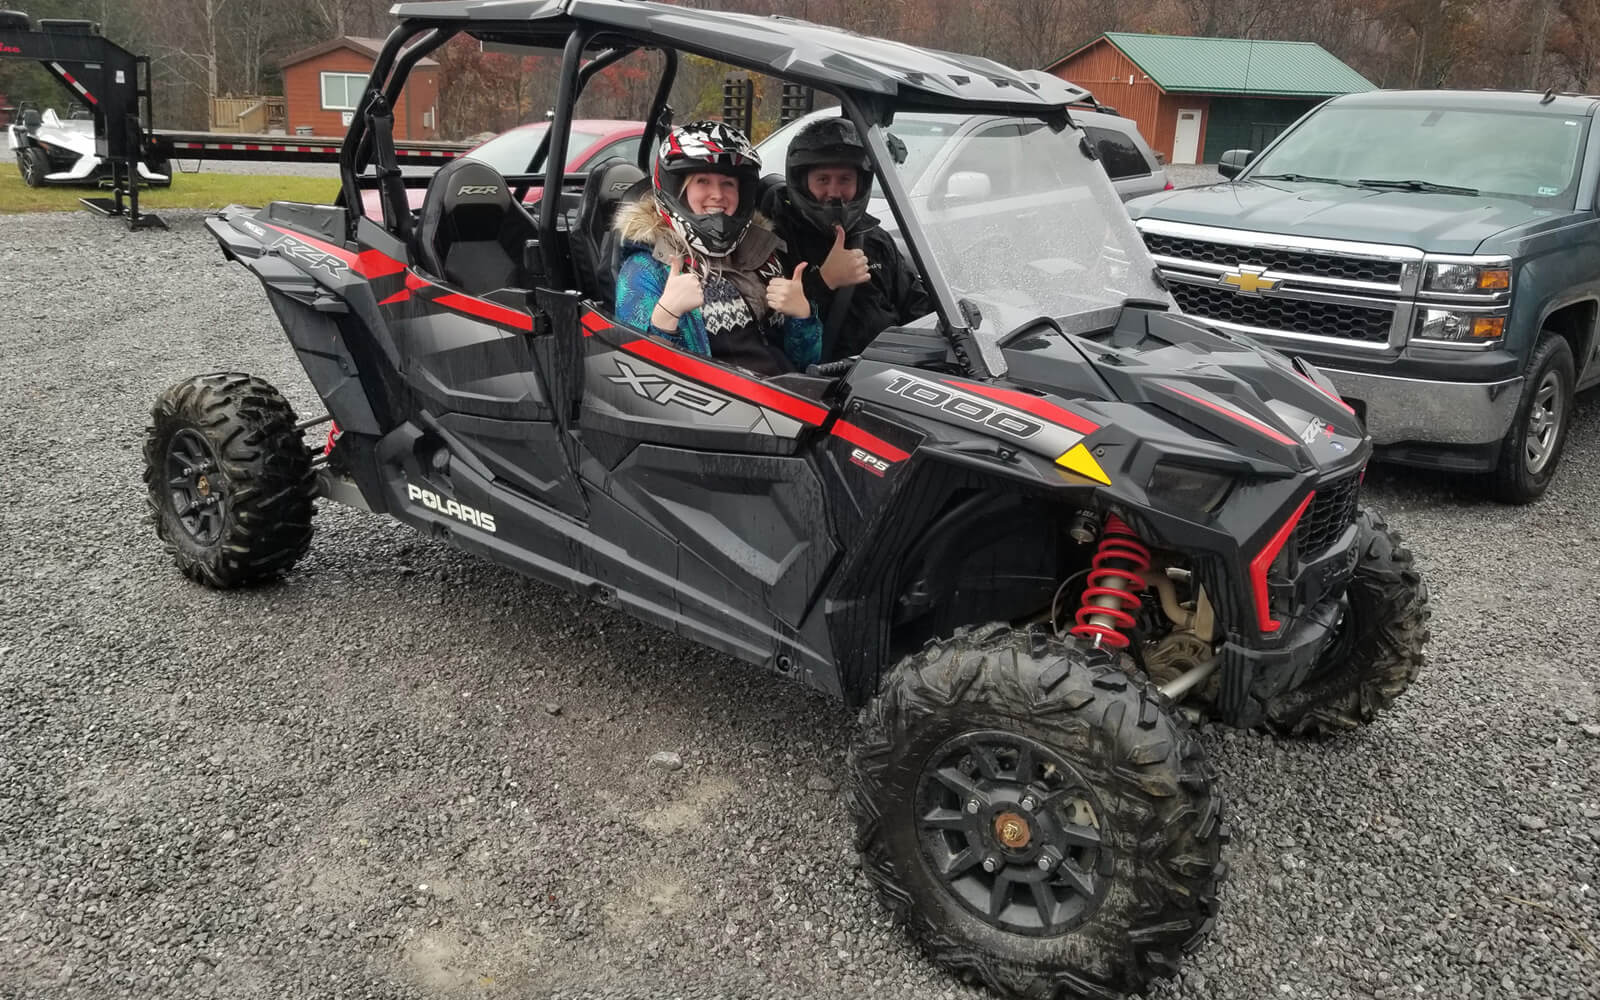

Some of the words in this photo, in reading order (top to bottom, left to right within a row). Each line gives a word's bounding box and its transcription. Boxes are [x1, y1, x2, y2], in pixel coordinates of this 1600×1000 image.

[457, 185, 498, 196] RZR
[609, 182, 635, 191] RZ
[271, 233, 349, 280] RZR
[607, 358, 732, 416] XP
[884, 375, 1045, 440] 1000
[851, 447, 890, 471] EPS
[407, 482, 497, 532] POLARIS
